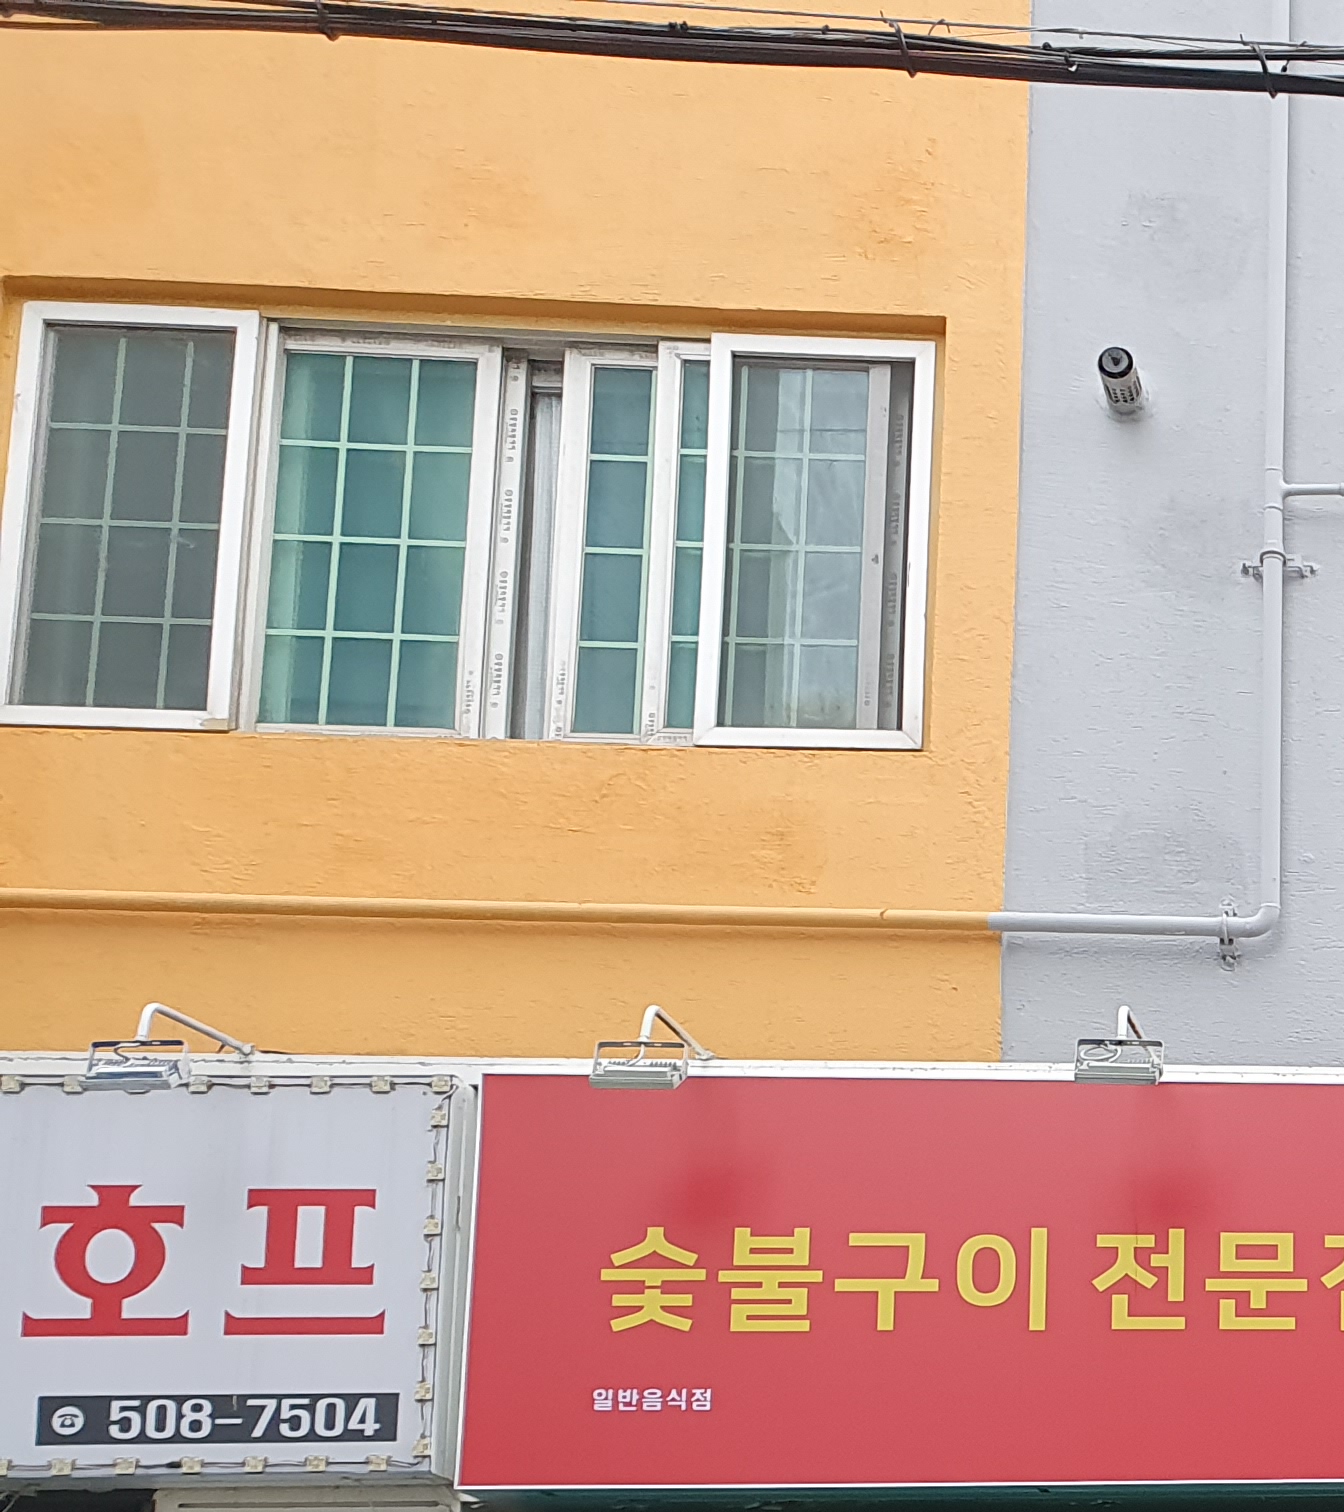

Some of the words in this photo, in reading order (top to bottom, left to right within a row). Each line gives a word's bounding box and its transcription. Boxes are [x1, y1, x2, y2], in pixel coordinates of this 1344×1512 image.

[20, 1184, 386, 1338] 호프
[599, 1226, 1049, 1333] 숯불구이
[108, 1396, 381, 1440] 508-7504
[591, 1387, 713, 1413] 일반음식점
